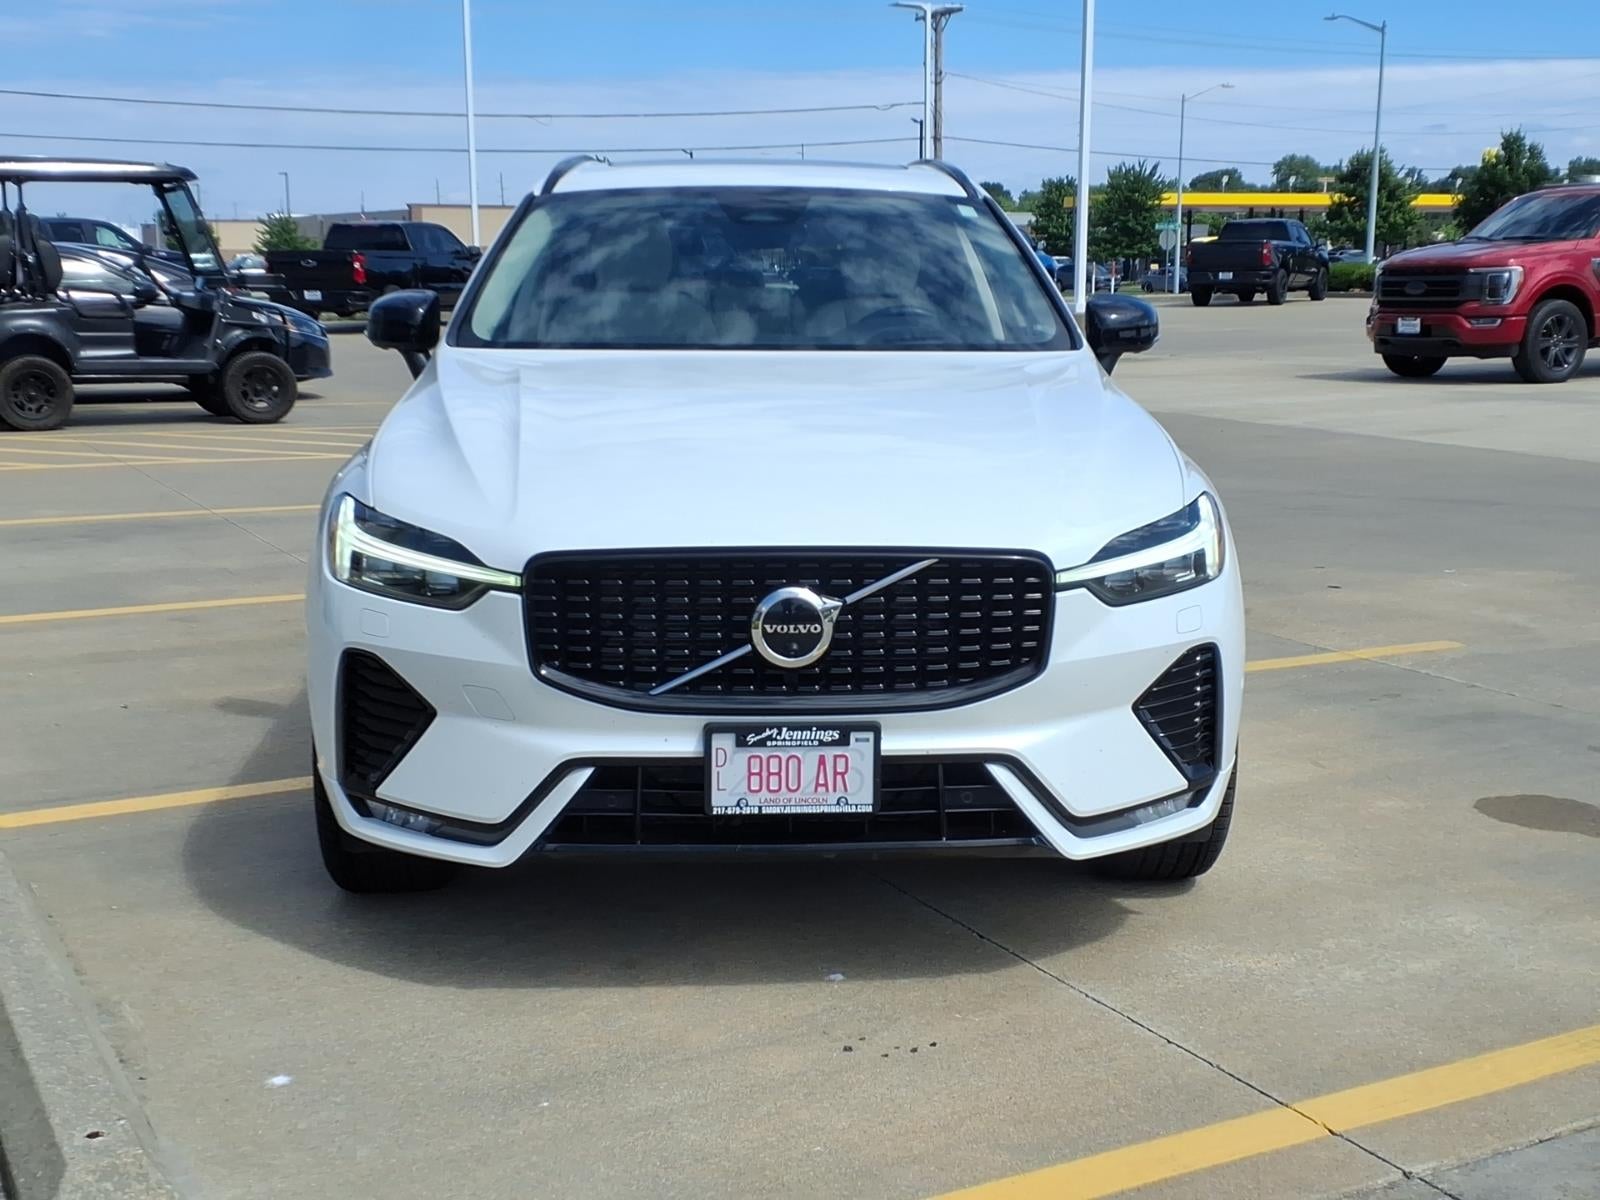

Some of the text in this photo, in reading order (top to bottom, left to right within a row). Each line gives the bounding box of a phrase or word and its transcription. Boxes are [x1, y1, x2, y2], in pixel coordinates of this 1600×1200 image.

[763, 623, 822, 634] VOLVO
[776, 726, 840, 742] Jennings
[747, 754, 849, 794] 880 AR
[759, 797, 781, 805] LAND
[794, 796, 828, 804] LINCOLN
